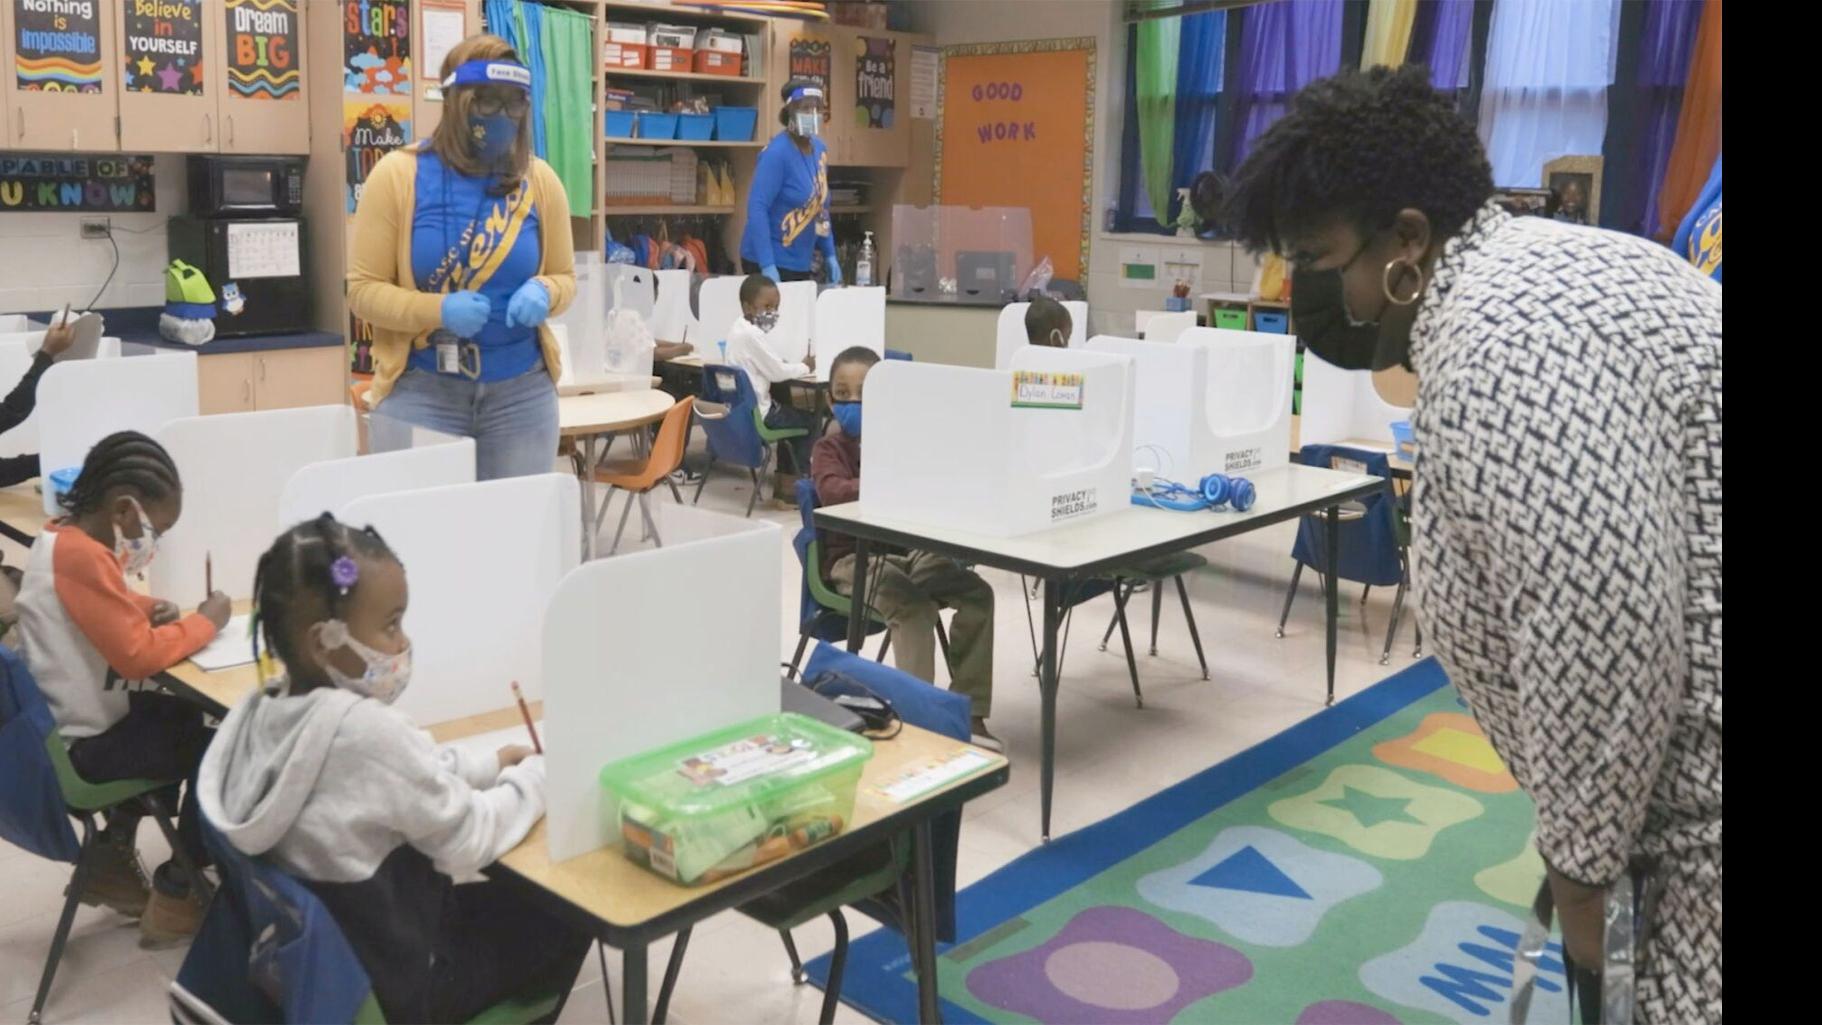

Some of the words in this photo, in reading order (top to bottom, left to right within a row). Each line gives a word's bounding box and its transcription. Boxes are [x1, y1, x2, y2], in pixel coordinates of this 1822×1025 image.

[23, 0, 93, 19] Nothing
[135, 0, 192, 20] Believe
[347, 0, 408, 38] stars
[54, 14, 67, 30] is
[153, 18, 173, 36] in
[21, 28, 96, 54] impossible
[129, 35, 198, 55] YOURSELF
[236, 35, 290, 68] BIG
[865, 59, 877, 73] Be
[858, 72, 892, 99] friend
[972, 82, 1022, 101] GOOD
[355, 127, 403, 145] Make
[977, 122, 1036, 143] WORK
[37, 181, 137, 208] KNOW
[1051, 489, 1087, 507] PRIVACY
